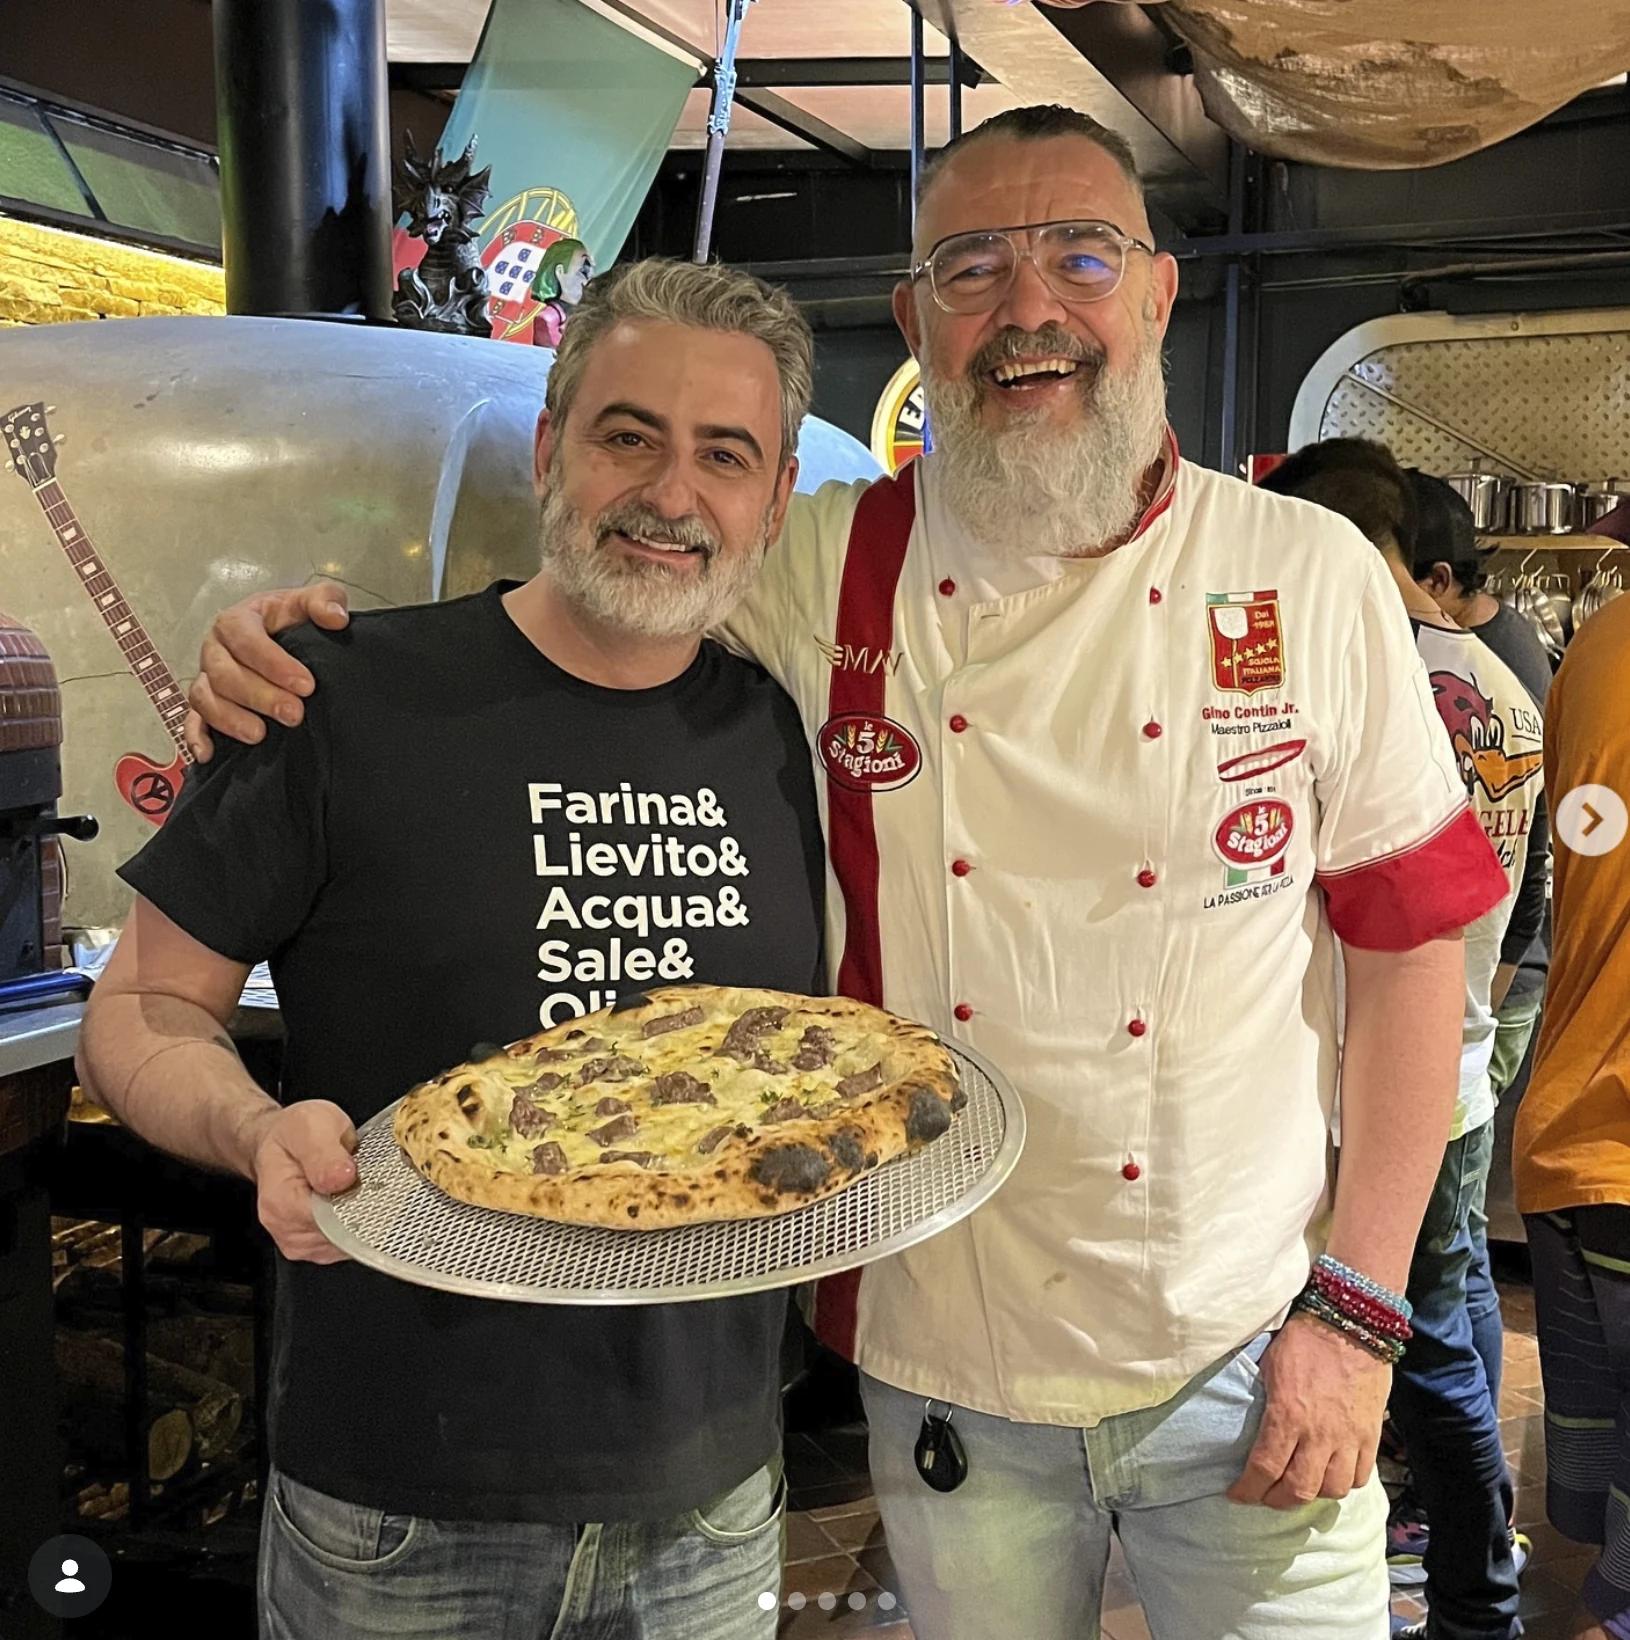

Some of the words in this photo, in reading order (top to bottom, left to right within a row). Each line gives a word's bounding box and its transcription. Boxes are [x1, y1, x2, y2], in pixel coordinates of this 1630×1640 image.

[1243, 665, 1282, 676] ITALIANA
[1202, 706, 1231, 719] Gino
[1234, 704, 1277, 719] Contin
[1281, 702, 1299, 715] Jr.
[1509, 707, 1542, 736] USA
[863, 721, 874, 731] le
[1211, 723, 1251, 735] Maestro
[856, 731, 876, 754] 5
[828, 740, 906, 778] Stagioni
[528, 782, 727, 827] Farina&
[1254, 812, 1269, 836] 5
[533, 832, 750, 877] Lievito&
[1203, 896, 1216, 909] LA
[1218, 887, 1260, 907] PASSIONE
[536, 885, 750, 938] Acqua&
[537, 937, 695, 982] Sale&
